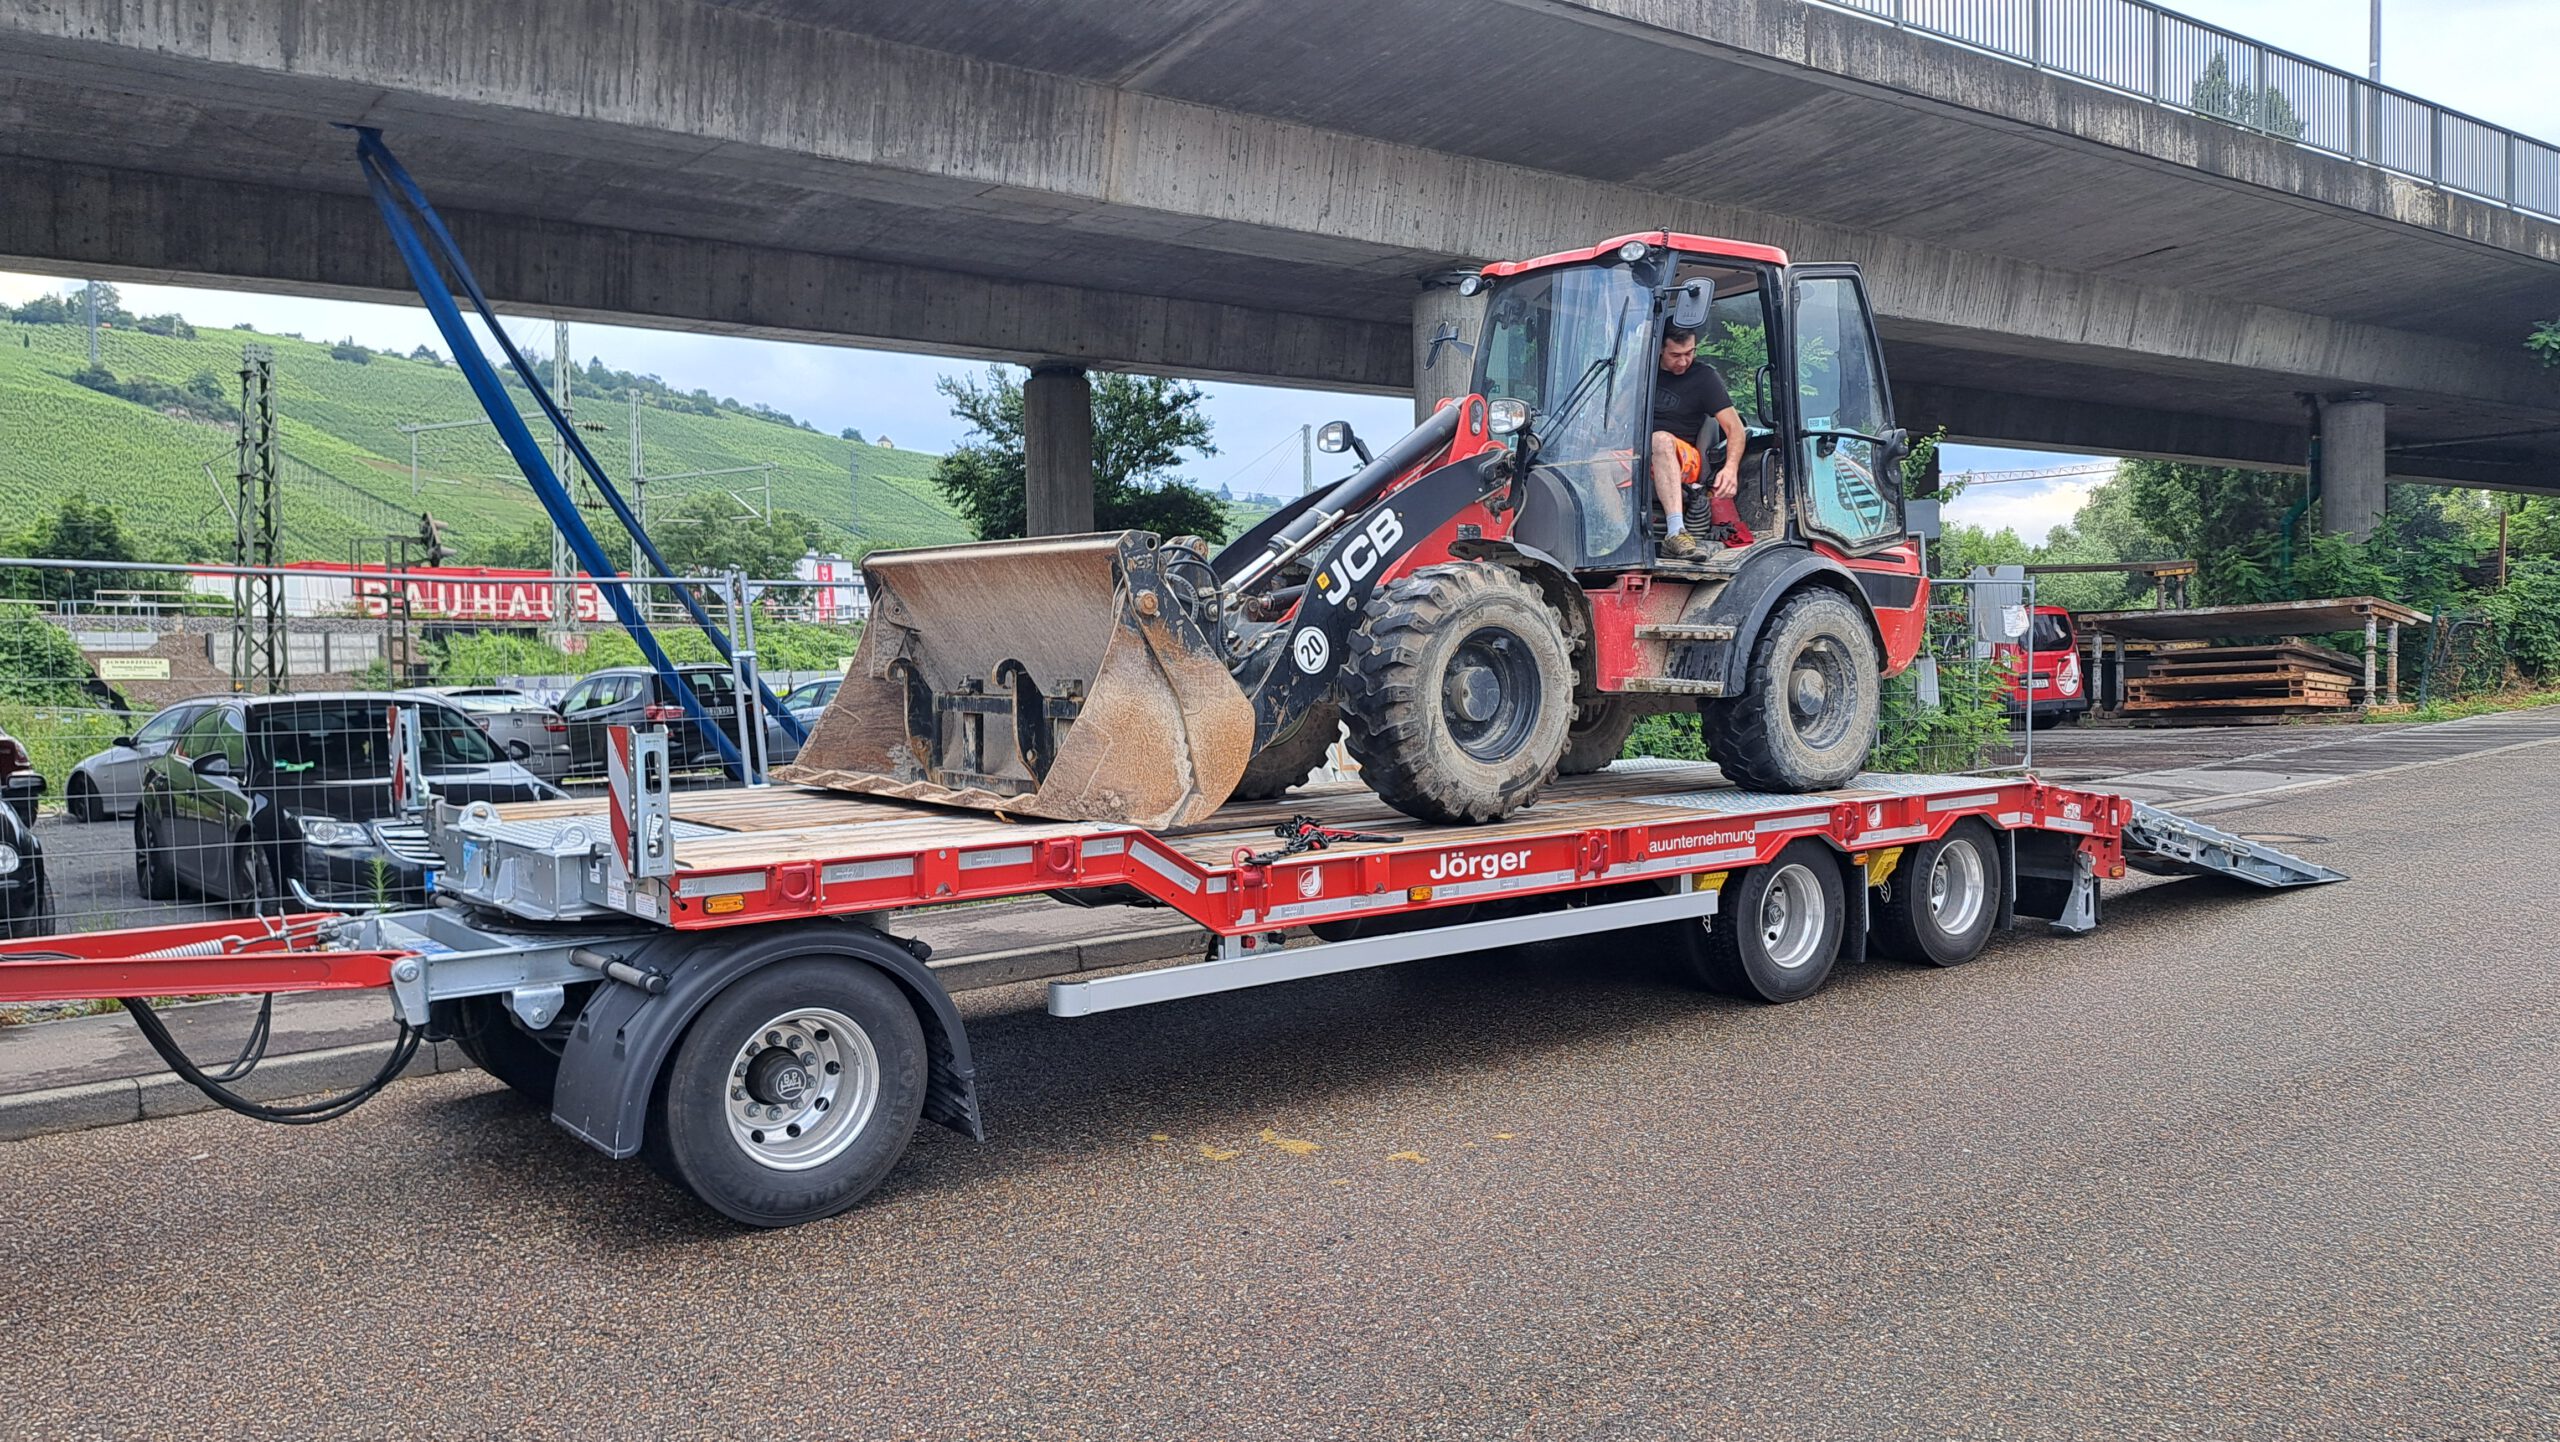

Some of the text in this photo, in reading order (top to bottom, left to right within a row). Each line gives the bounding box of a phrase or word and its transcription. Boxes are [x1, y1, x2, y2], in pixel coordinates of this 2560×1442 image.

[1326, 508, 1404, 606] JCB
[362, 580, 597, 619] BAUHAUS
[1301, 635, 1323, 667] 20
[1649, 829, 1756, 853] auunternehmung
[1430, 849, 1532, 880] Jörger
